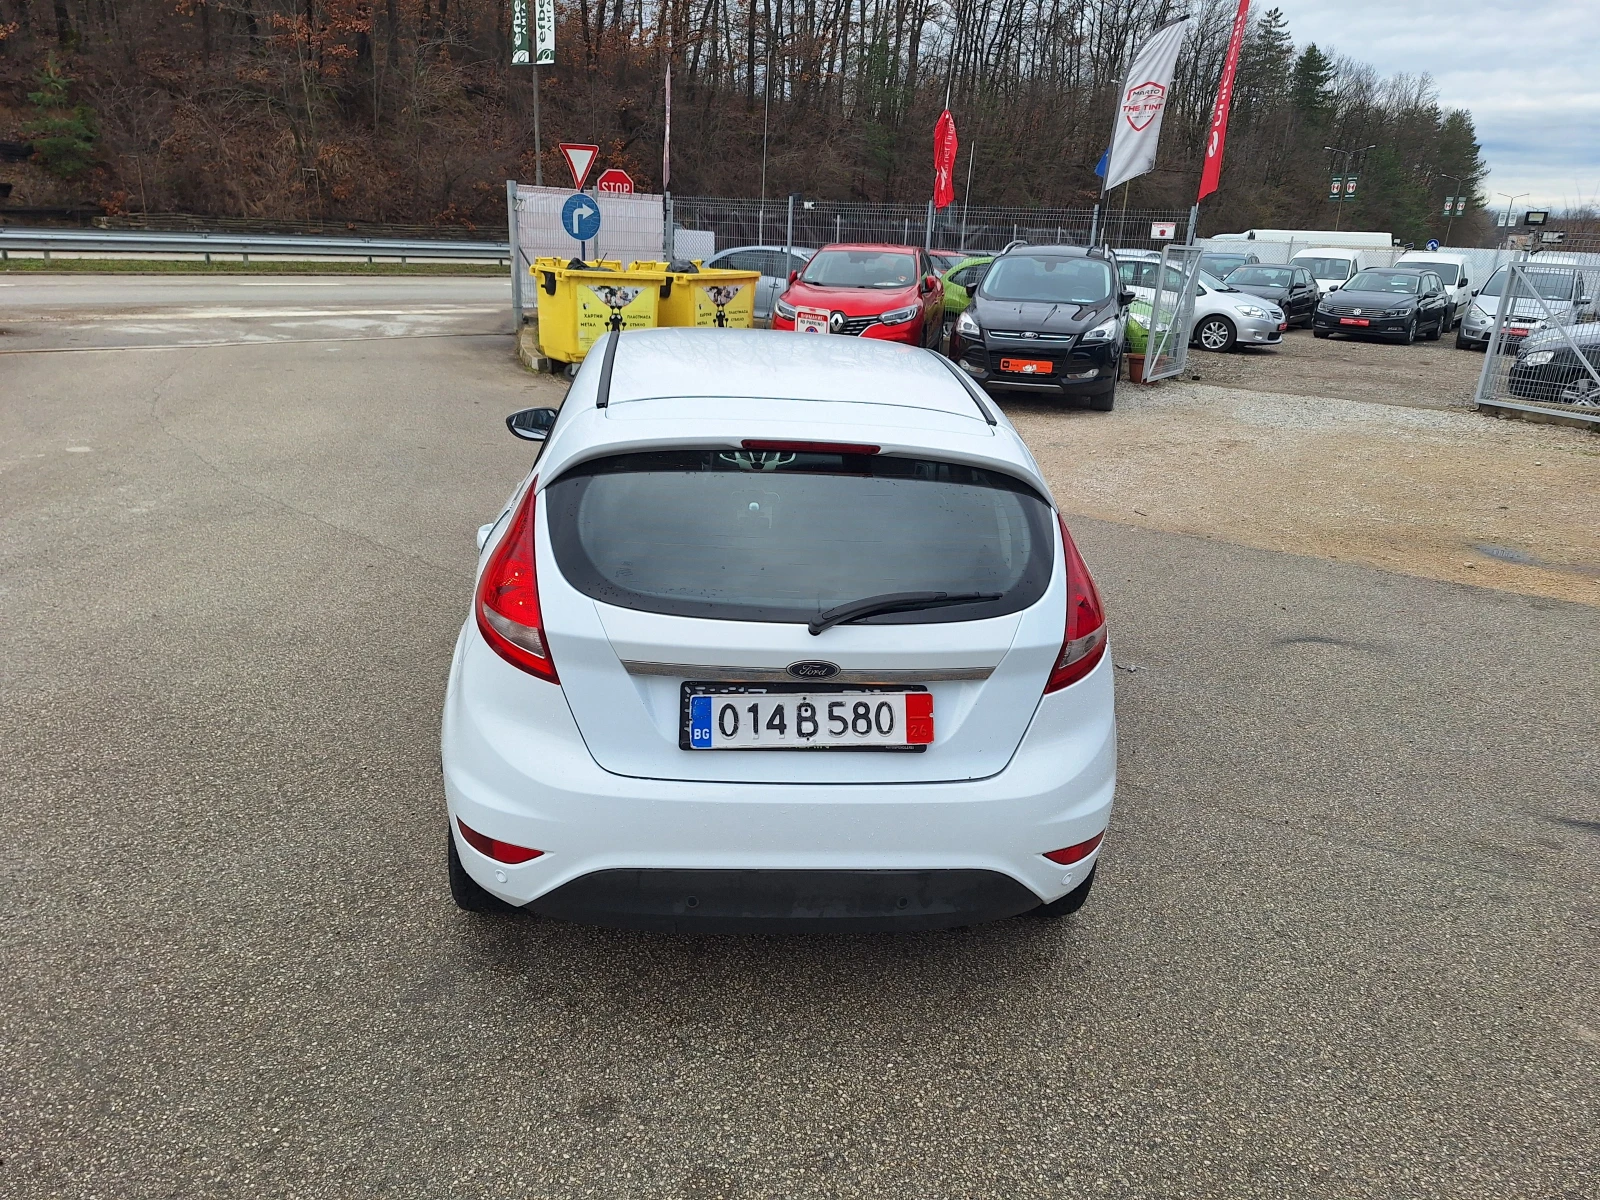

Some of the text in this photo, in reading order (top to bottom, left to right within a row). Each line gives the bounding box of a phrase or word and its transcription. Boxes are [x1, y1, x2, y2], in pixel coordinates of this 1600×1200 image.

[1143, 103, 1163, 111] TINT
[601, 181, 630, 193] STOP
[799, 664, 828, 676] Ford
[693, 728, 710, 740] BG
